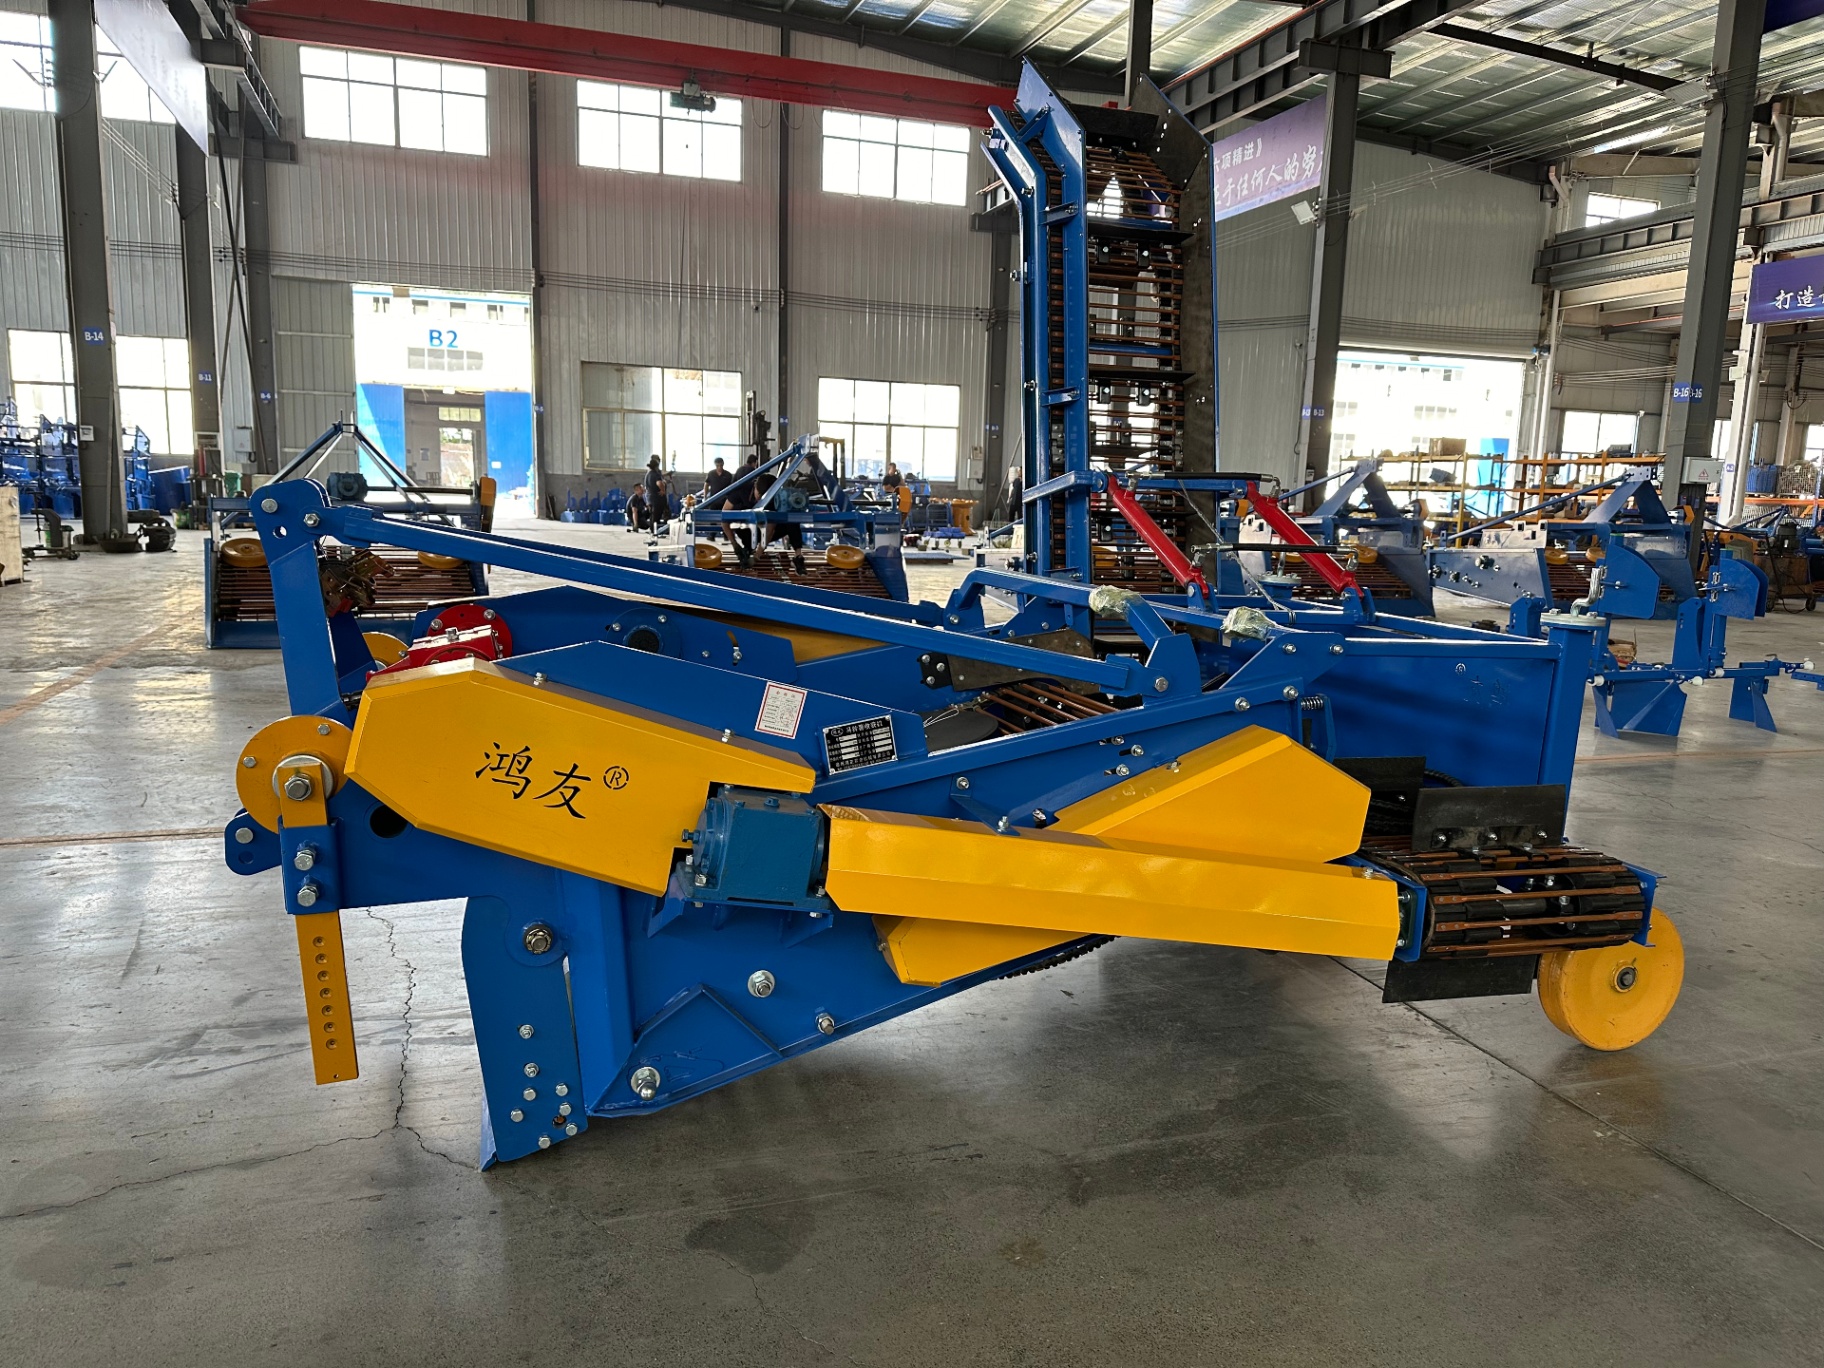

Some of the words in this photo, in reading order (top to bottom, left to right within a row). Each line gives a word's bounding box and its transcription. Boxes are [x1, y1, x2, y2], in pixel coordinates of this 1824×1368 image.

[84, 331, 104, 341] B-14
[429, 329, 459, 348] B2
[1673, 387, 1690, 398] B-16
[475, 742, 592, 819] 鸿友
